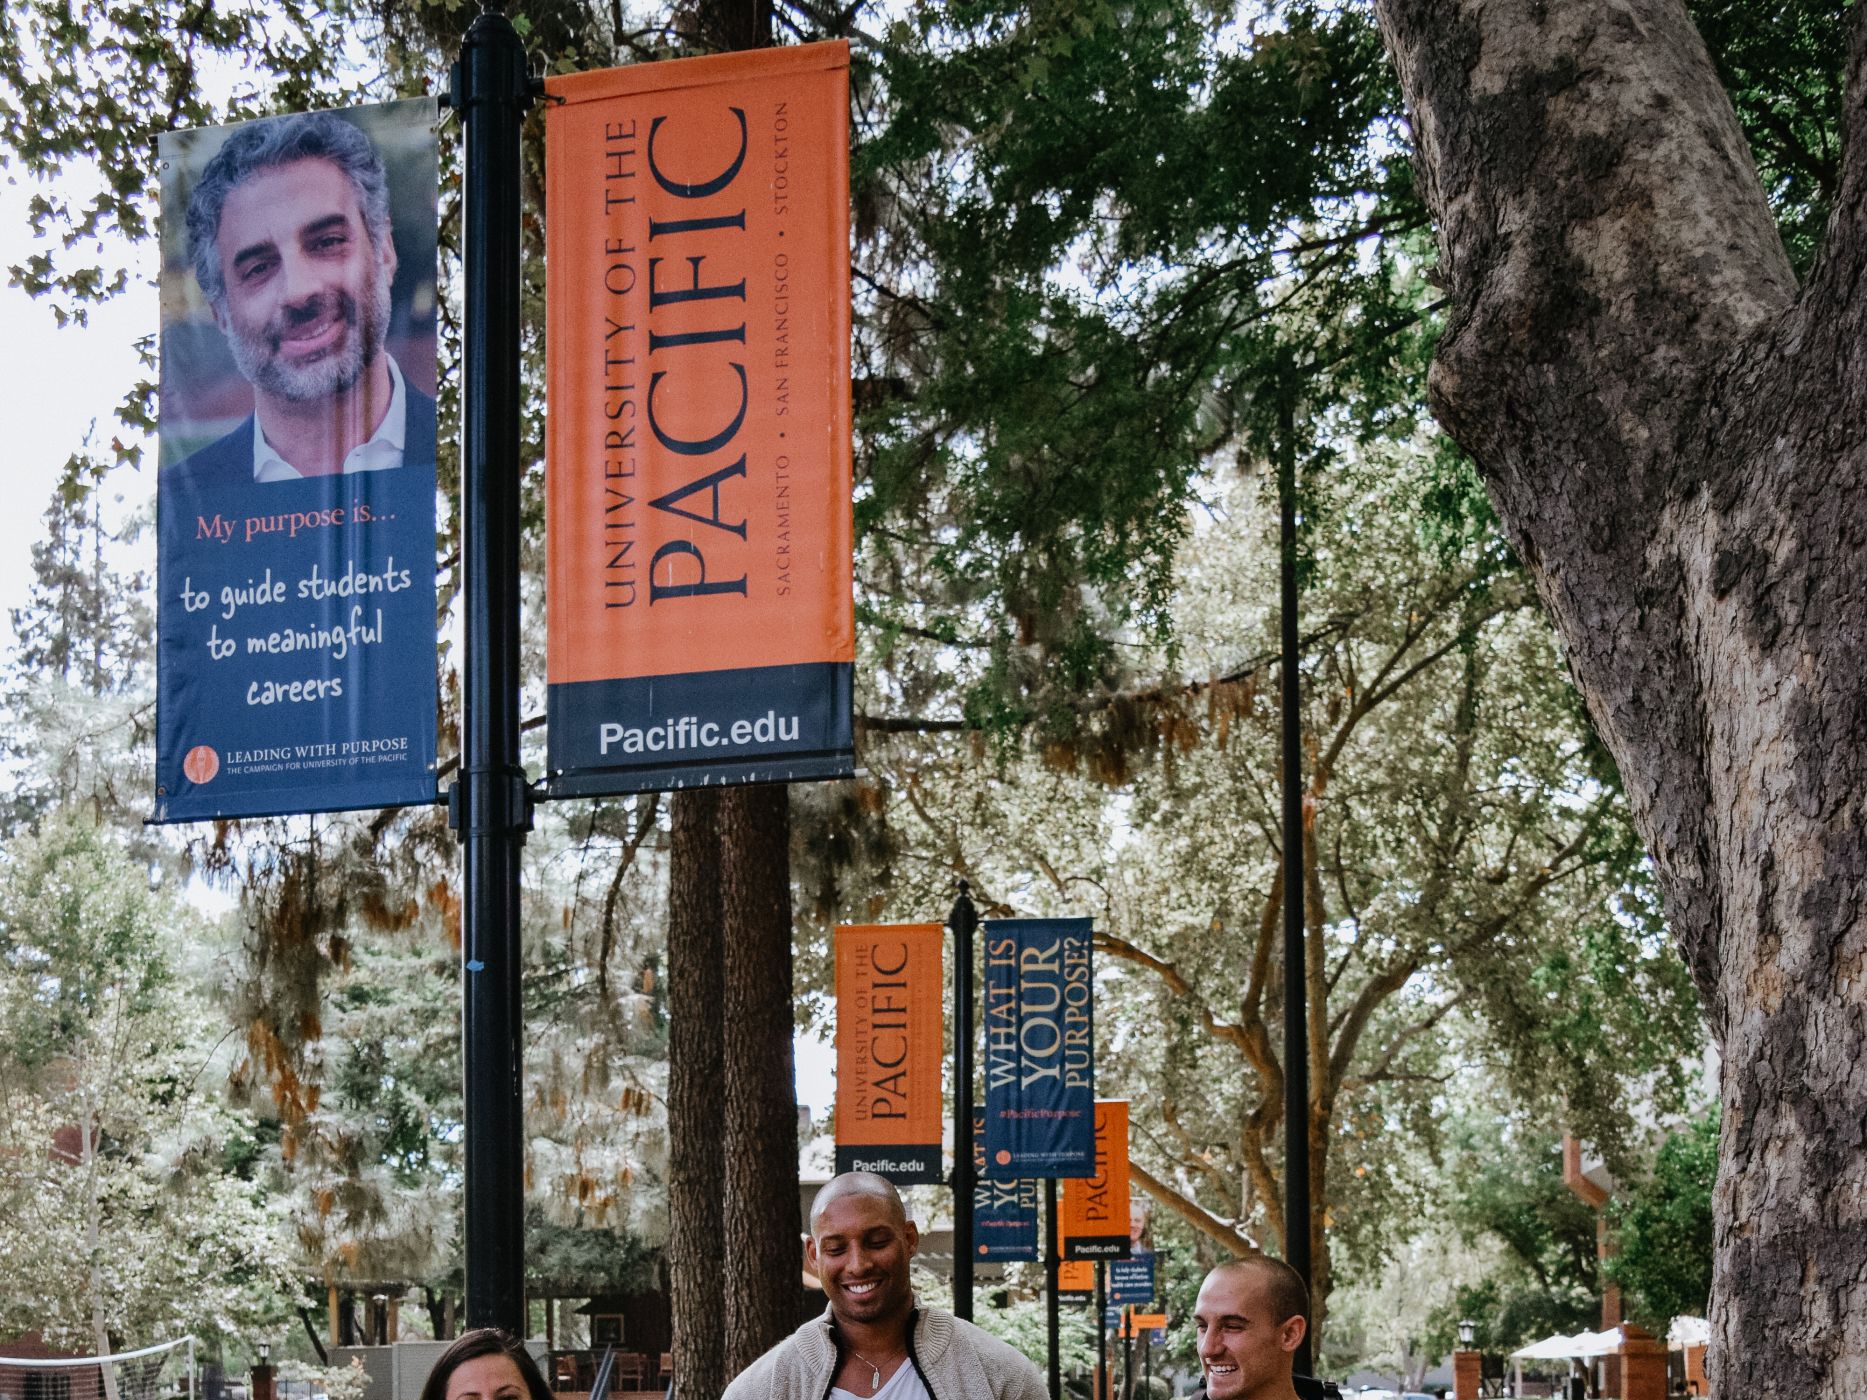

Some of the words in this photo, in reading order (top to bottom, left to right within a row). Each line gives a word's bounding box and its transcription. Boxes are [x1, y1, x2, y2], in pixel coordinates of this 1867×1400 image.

[605, 119, 636, 215] THE
[775, 102, 788, 216] STOCKTON
[605, 239, 636, 295] OF
[775, 253, 789, 369] FRANCISCO
[647, 106, 748, 607] PACIFIC
[775, 377, 789, 416] SAN
[605, 316, 636, 609] UNIVERSITY
[195, 516, 237, 544] My
[245, 507, 345, 541] purpose
[776, 455, 790, 596] SACRAMENTO
[180, 576, 210, 612] to
[221, 568, 286, 620] guide
[298, 556, 411, 600] students
[207, 624, 236, 660] to
[247, 605, 383, 660] meaningful
[247, 678, 343, 706] careers
[227, 747, 291, 764] LEADING
[295, 743, 336, 758] WITH
[342, 737, 408, 755] PURPOSE
[600, 710, 799, 755] Pacific.edu
[227, 766, 241, 775] THE
[244, 763, 284, 774] CAMPAIGN
[285, 761, 301, 770] FOR
[303, 758, 346, 769] UNIVERSITY
[349, 756, 360, 765] OF
[361, 755, 376, 764] THE
[378, 753, 407, 762] PACIFIC
[856, 944, 868, 978] THE
[988, 938, 1016, 967] IS
[856, 988, 868, 1009] OF
[1020, 937, 1061, 1091] YOUR
[1063, 936, 1089, 1089] PURPOSE?
[871, 943, 908, 1120] PACIFIC
[989, 980, 1017, 1091] WHAT
[856, 1015, 868, 1121] UNIVERSITY
[853, 1158, 925, 1173] Pacific.edu
[1075, 1244, 1120, 1254] Pacific.edu
